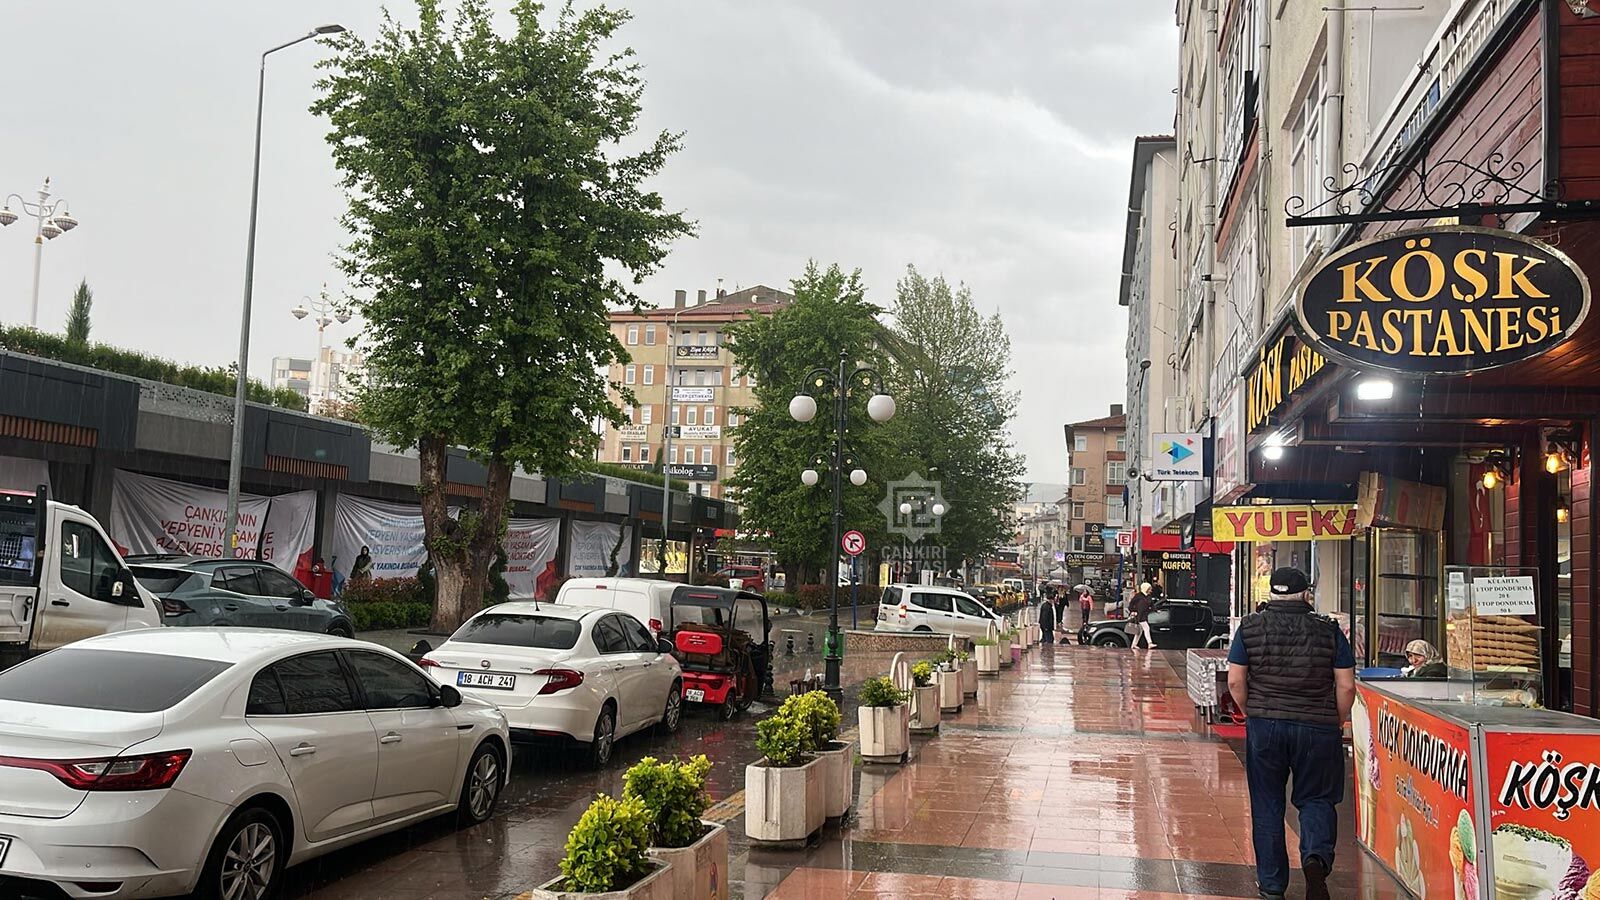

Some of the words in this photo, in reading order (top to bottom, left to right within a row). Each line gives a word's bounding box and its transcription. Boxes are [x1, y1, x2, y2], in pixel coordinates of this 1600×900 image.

[1336, 237, 1551, 303] KÖŞK
[1247, 336, 1285, 435] KÖŞK
[1121, 536, 1129, 544] E
[463, 673, 472, 681] 18
[477, 675, 493, 686] ACH
[499, 676, 513, 687] 241
[1377, 700, 1401, 762] KÖŞK
[1401, 719, 1469, 805] DONDURMA
